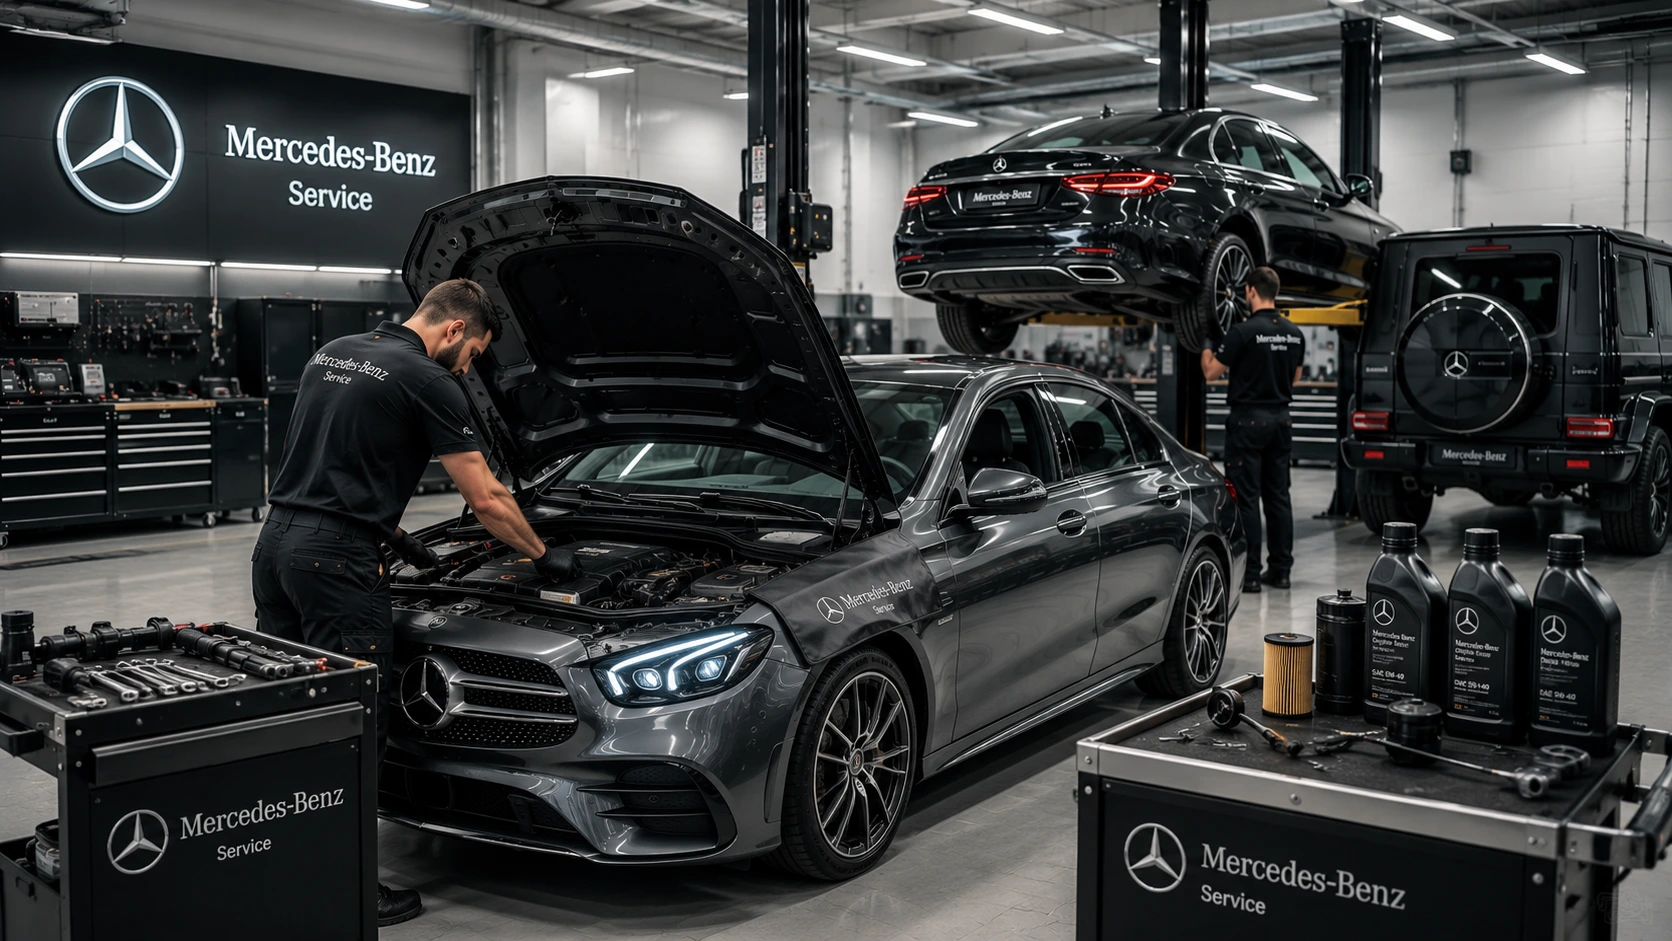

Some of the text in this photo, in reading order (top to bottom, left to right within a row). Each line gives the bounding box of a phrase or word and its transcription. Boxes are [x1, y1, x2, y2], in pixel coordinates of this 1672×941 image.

[224, 124, 436, 177] Mercedes-Benz
[288, 180, 373, 211] Service
[973, 190, 1033, 202] Mercedes-Benz
[310, 353, 389, 382] Mercedes-Benz
[323, 370, 352, 385] Service
[180, 788, 345, 840] Mercedes-Benz
[216, 838, 272, 861] Service
[1200, 843, 1407, 910] Mercedes-Benz
[1200, 884, 1267, 915] Service
